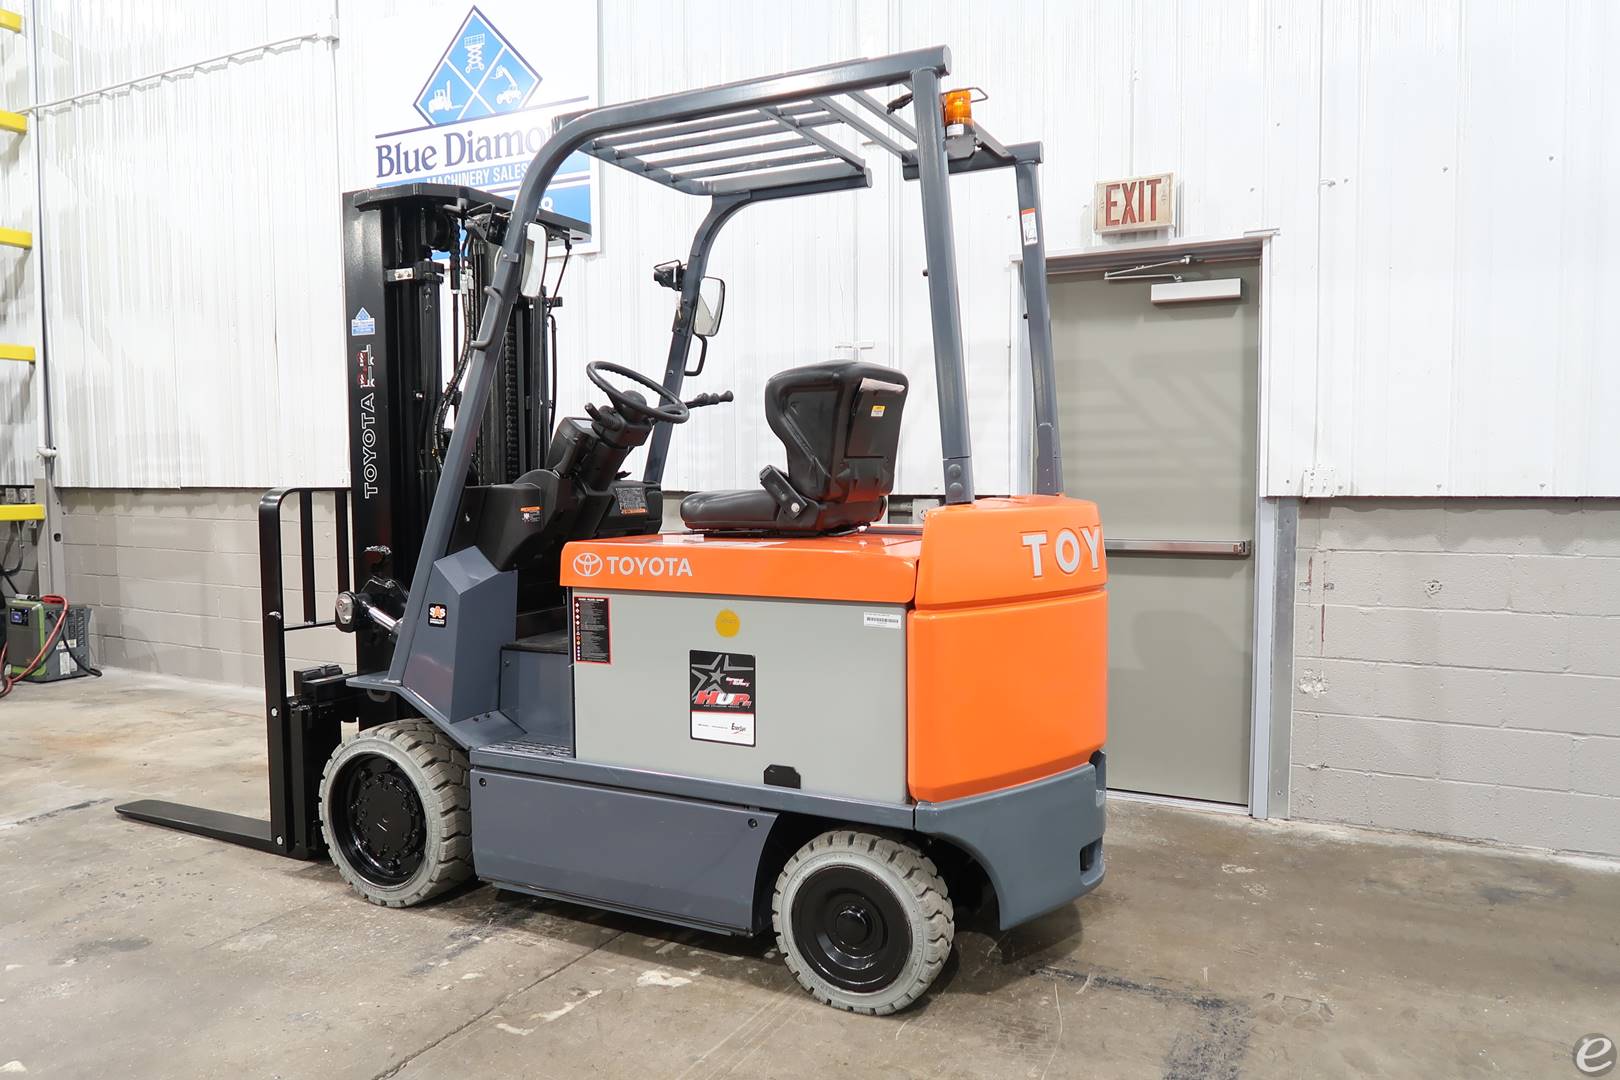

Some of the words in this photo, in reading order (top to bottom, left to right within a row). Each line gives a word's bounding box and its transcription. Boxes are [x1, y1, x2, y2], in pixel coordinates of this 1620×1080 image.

[376, 141, 437, 178] Blue
[493, 162, 528, 182] SALES
[1105, 178, 1162, 226] EXIT
[360, 392, 378, 499] TOYOTA
[606, 556, 693, 576] TOYOTA
[1022, 526, 1106, 577] TOY
[429, 605, 446, 618] SAS
